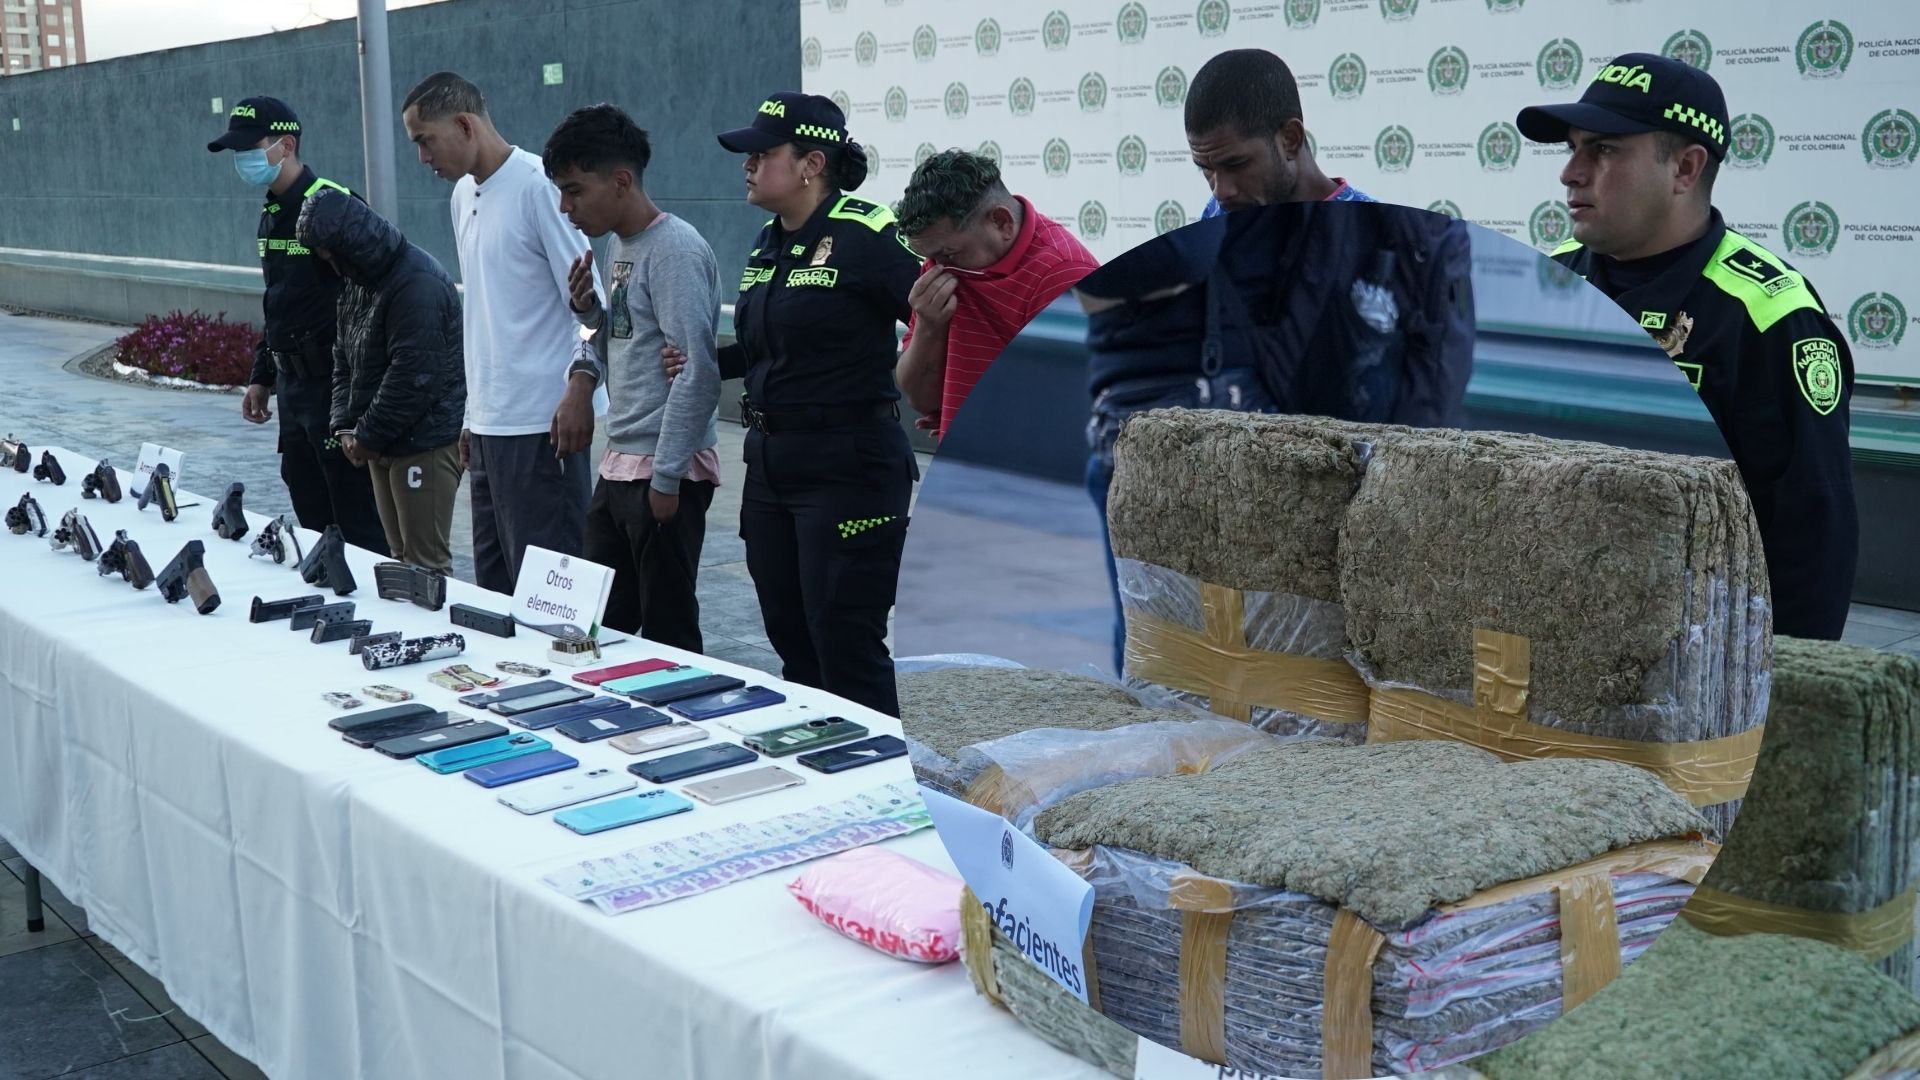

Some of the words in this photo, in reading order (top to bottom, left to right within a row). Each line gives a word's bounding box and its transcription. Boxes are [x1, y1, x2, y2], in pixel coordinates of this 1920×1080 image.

[1895, 38, 1920, 46] NACIO
[1750, 45, 1791, 54] NACIONAL
[1882, 48, 1920, 56] COLOMB
[1737, 55, 1780, 64] COLOMBIA
[1498, 61, 1533, 69] NACIONAL
[1393, 67, 1424, 75] NACIONAL
[1489, 70, 1524, 78] COLOMBIA
[1385, 75, 1416, 83] COLOMBIA
[1592, 64, 1651, 93] ICÍA
[758, 100, 785, 118] ICÍA
[1813, 133, 1857, 141] NACIONAL
[1802, 143, 1846, 151] COLOMBIA
[1880, 224, 1920, 232] NACIONA
[1867, 233, 1914, 241] COLOMBIA
[407, 466, 422, 488] C
[546, 569, 573, 590] Otros
[527, 593, 578, 621] elementos
